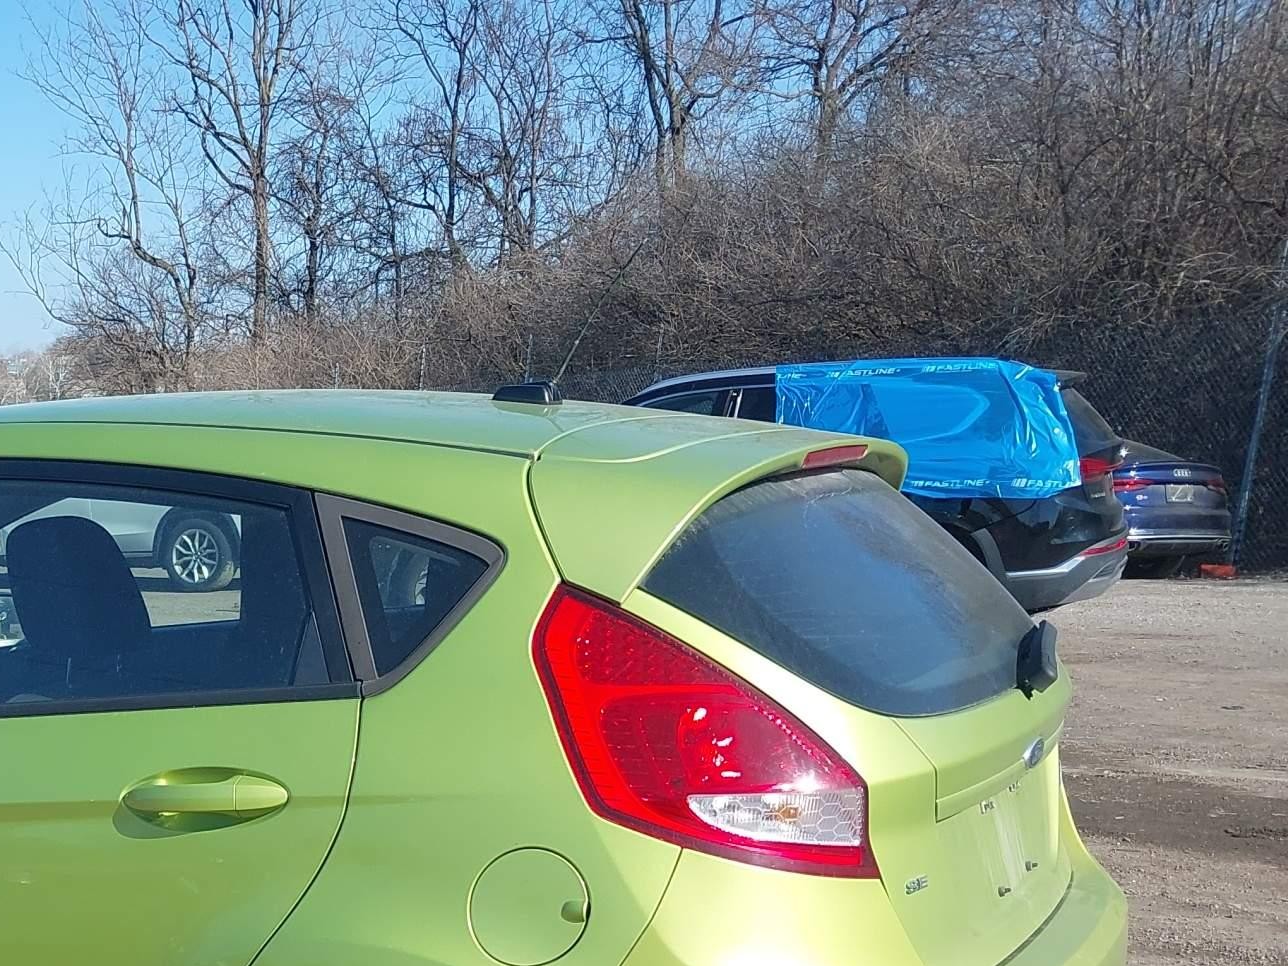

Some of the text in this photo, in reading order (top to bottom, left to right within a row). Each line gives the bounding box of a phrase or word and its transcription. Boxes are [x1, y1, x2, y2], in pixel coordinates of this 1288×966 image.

[936, 361, 997, 371] FASTLINE
[840, 367, 897, 377] ASTLINE
[924, 479, 985, 487] FASTLINE
